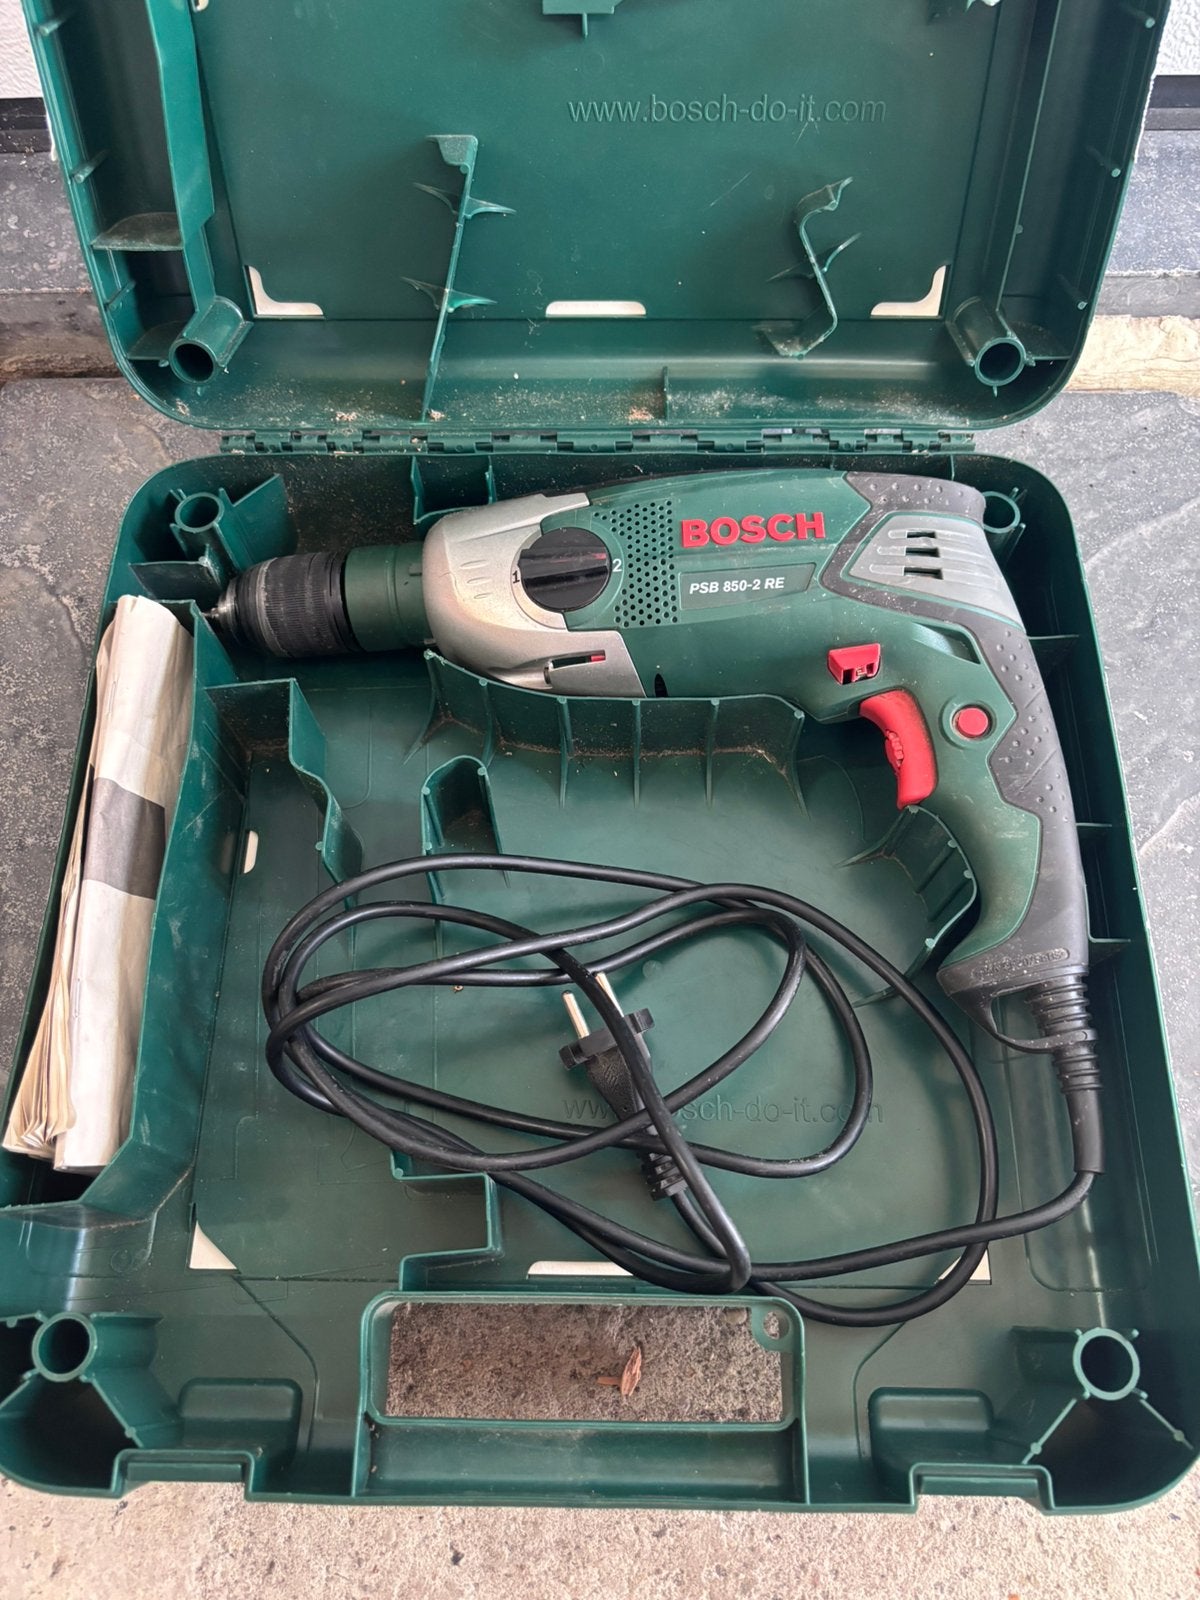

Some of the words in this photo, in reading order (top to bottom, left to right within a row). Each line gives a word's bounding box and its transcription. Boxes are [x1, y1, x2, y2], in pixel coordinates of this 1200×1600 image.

[567, 93, 888, 123] www.bosch-do-it.com
[681, 511, 826, 548] BOSCH
[512, 570, 521, 584] 1
[612, 558, 623, 573] 2
[689, 581, 720, 595] PSB
[723, 578, 761, 593] 850-2
[764, 577, 785, 590] RE
[563, 1094, 885, 1124] wwsch-do-it.co
